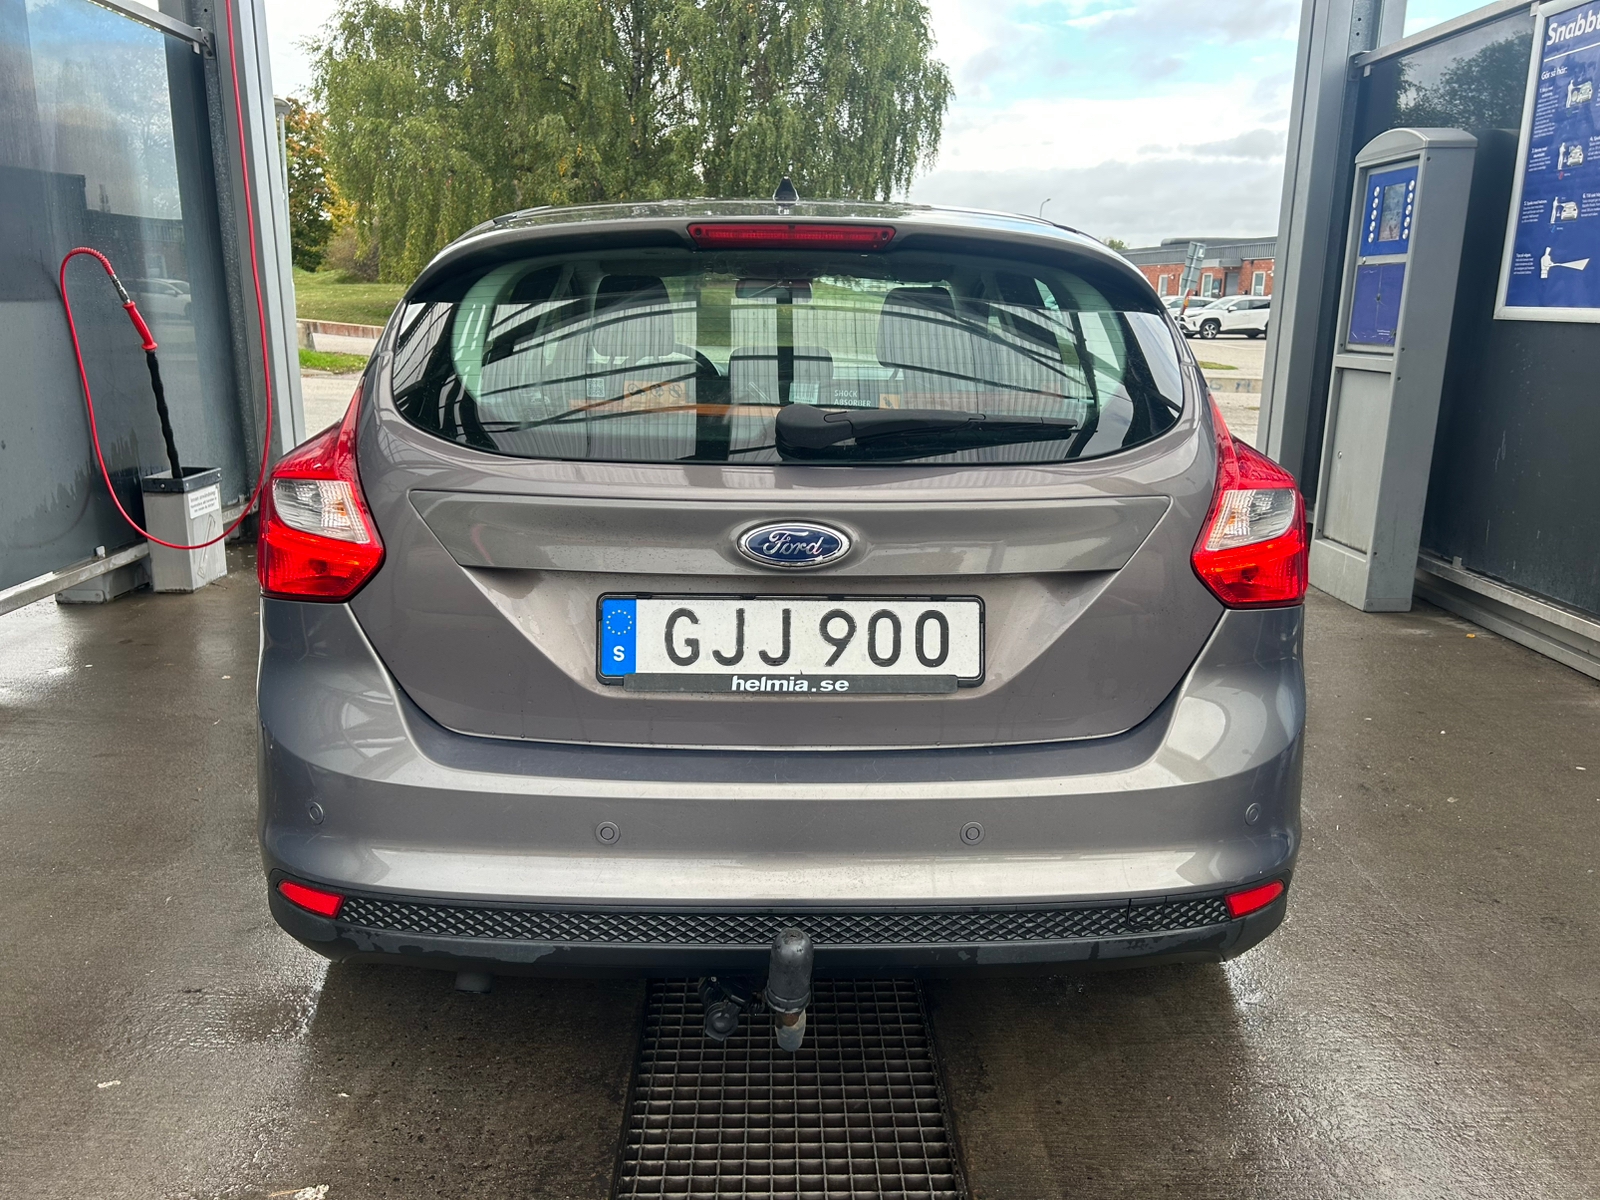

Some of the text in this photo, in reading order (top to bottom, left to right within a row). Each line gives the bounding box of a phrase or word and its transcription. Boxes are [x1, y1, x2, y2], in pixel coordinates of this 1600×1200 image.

[834, 389, 858, 398] SHOCK
[833, 398, 872, 408] ABSORBER
[762, 530, 825, 555] Ford
[664, 607, 950, 668] GJJ 900
[613, 645, 625, 662] S
[731, 675, 850, 692] helmia.se
